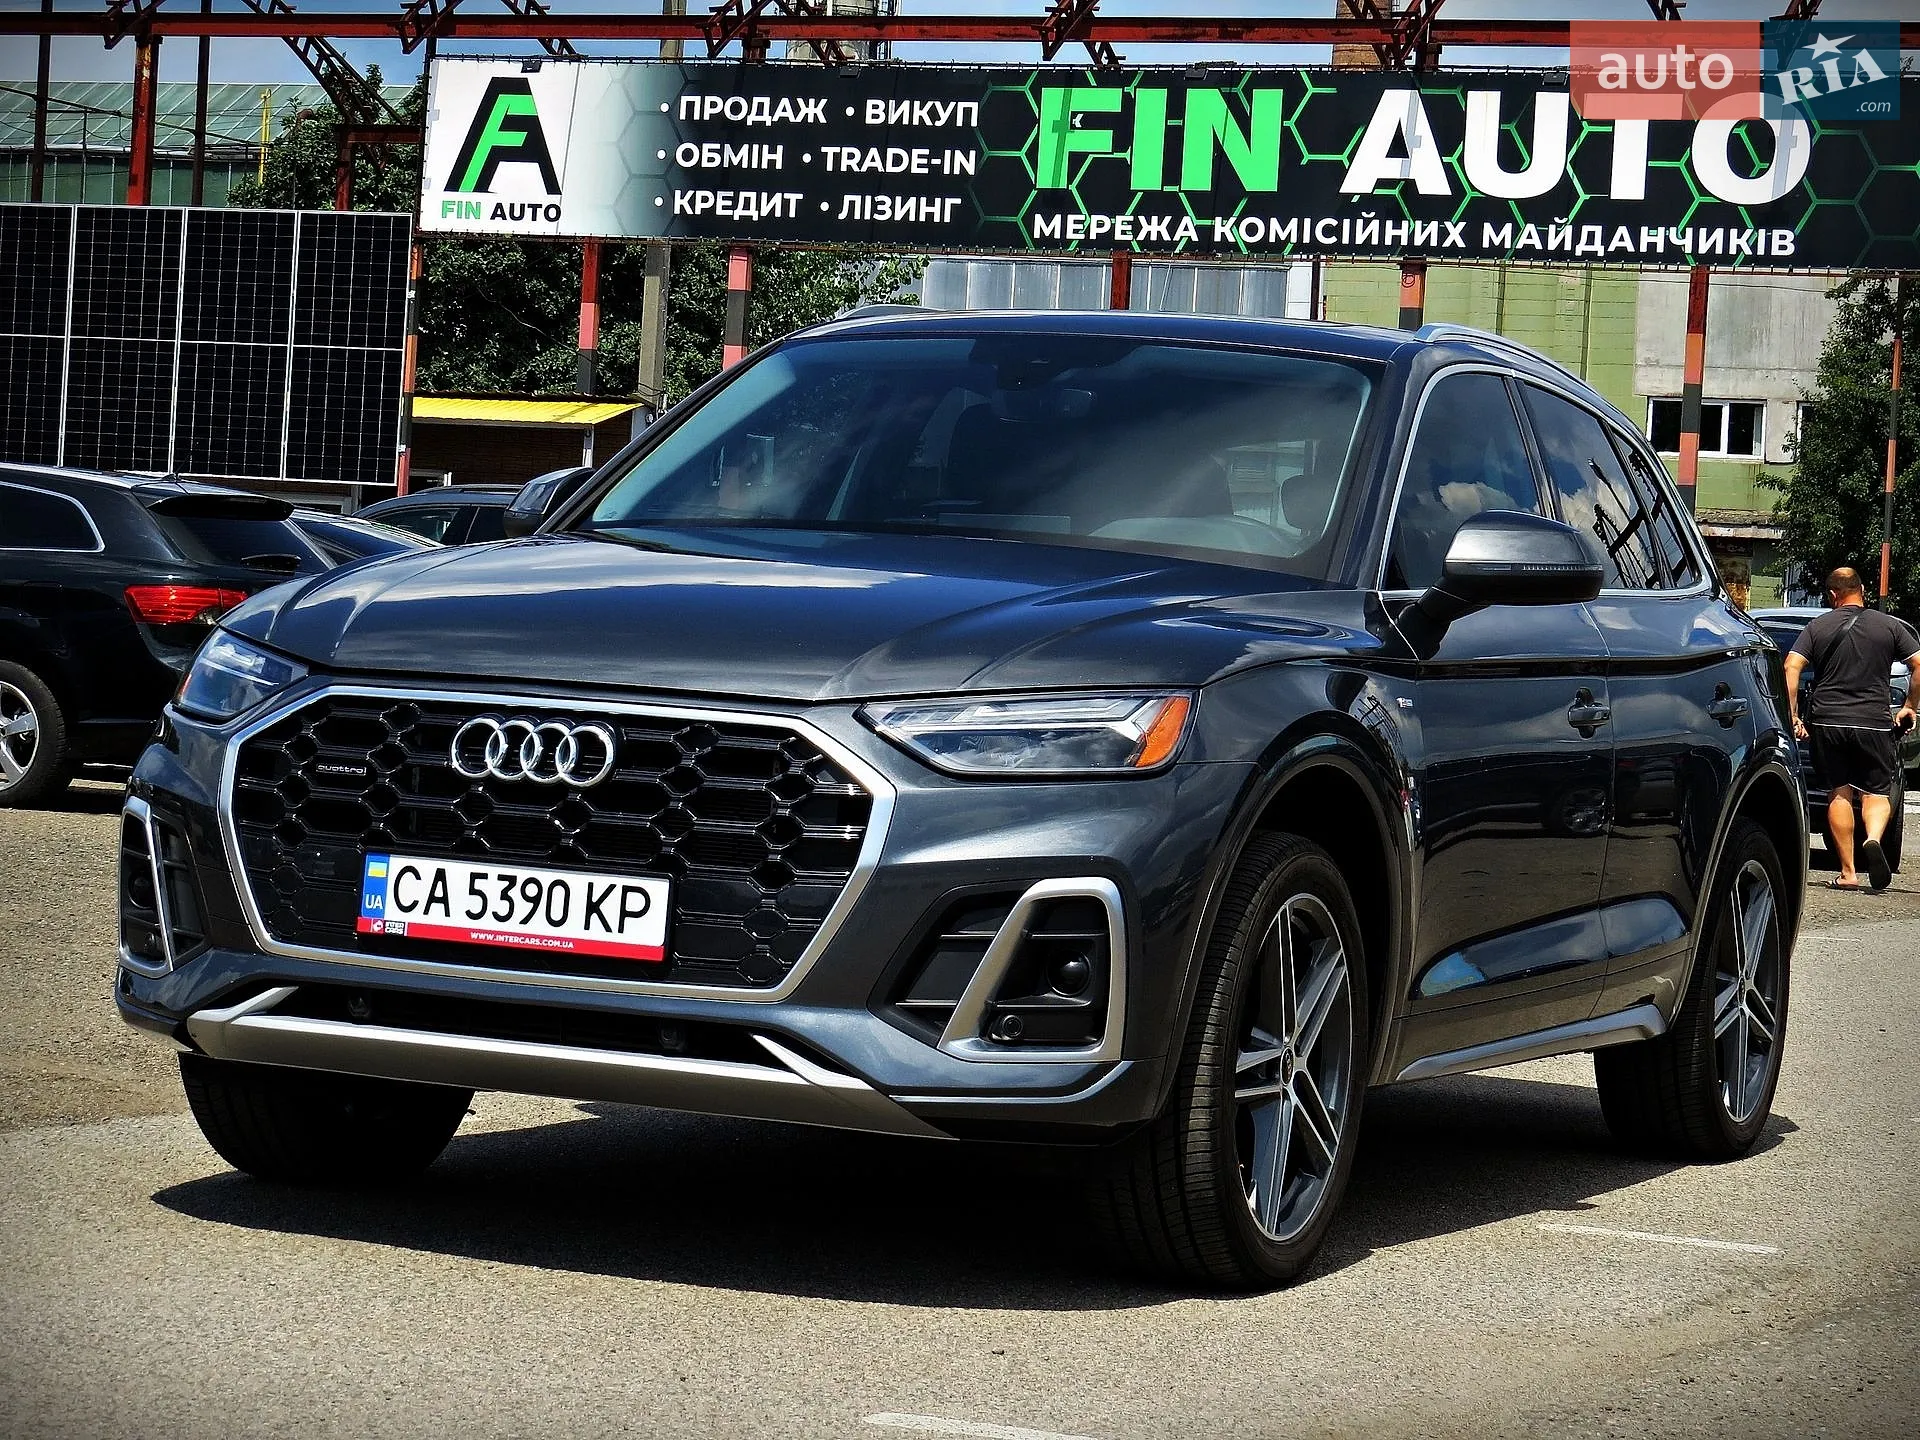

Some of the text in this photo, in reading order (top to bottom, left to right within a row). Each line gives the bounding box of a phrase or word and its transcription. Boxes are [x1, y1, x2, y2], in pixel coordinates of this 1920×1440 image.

[678, 95, 981, 128] ПРОДАЖ ВИКУП
[674, 142, 977, 176] ОБМІН TRADE-IN
[1035, 87, 1812, 205] FIN AUTO
[441, 200, 562, 222] FIN AUTO
[672, 190, 963, 222] КРЕДИТ ЛІЗИНГ
[1033, 211, 1796, 256] МЕРЕЖА КОМІСІЙНИХ МАЙДАНЧИКІВ
[365, 893, 384, 910] UA
[465, 871, 571, 928] 5390
[470, 931, 574, 948] WWW.INTERCARS.COM.UA
